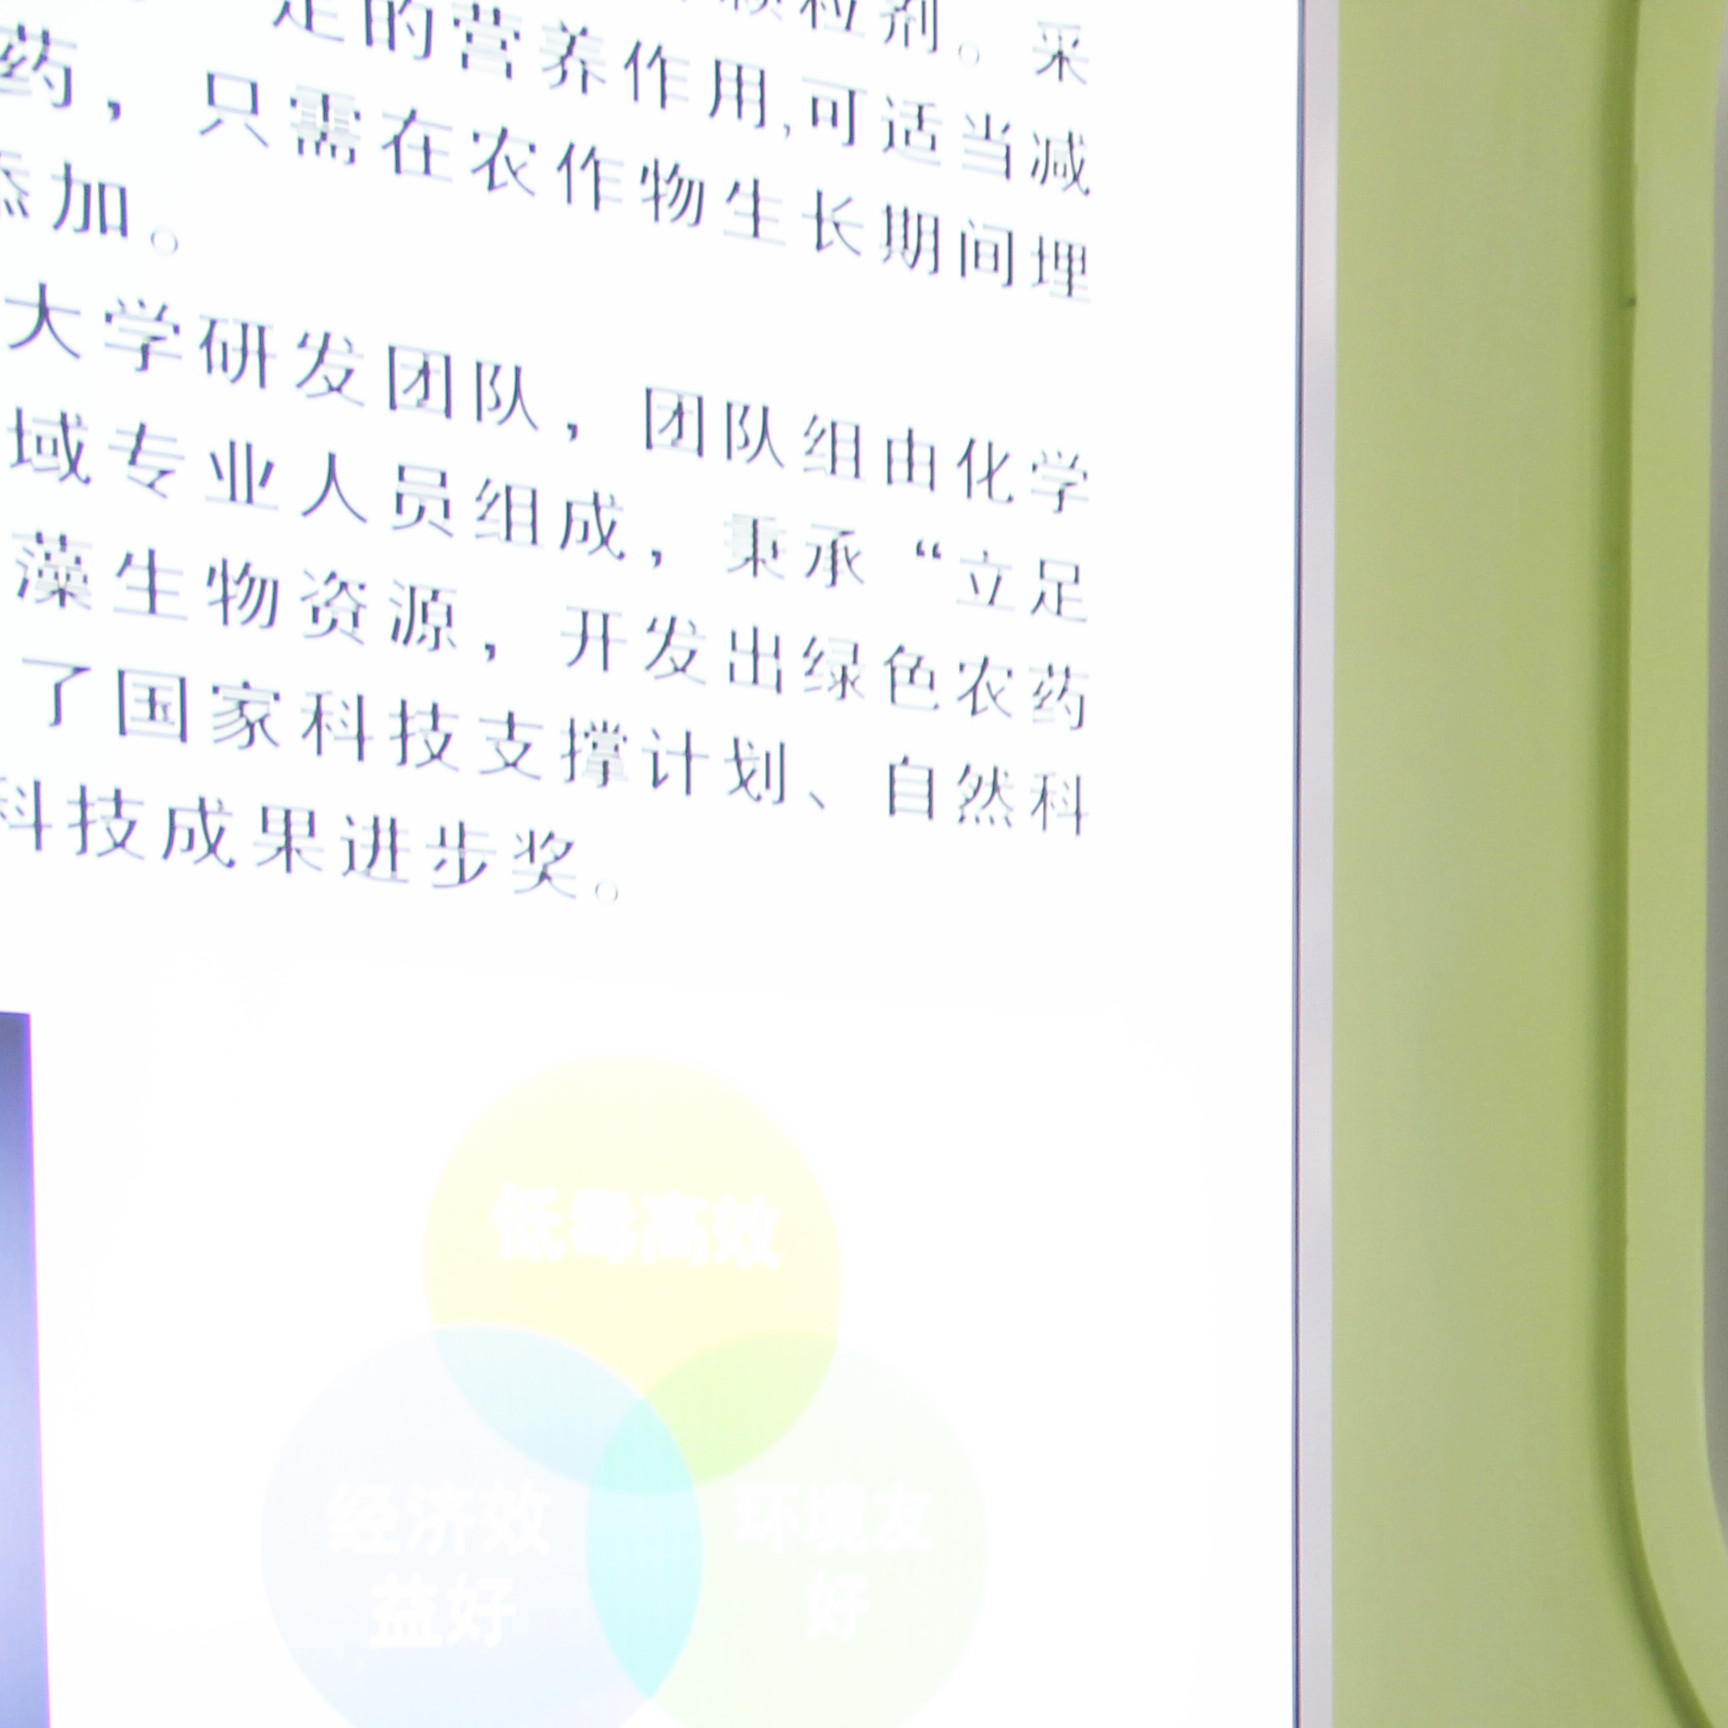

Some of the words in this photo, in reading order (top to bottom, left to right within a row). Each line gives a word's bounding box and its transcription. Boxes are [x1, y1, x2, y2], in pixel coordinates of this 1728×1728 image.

[326, 1479, 552, 1557] 经济效
[369, 1571, 517, 1650] 益好
